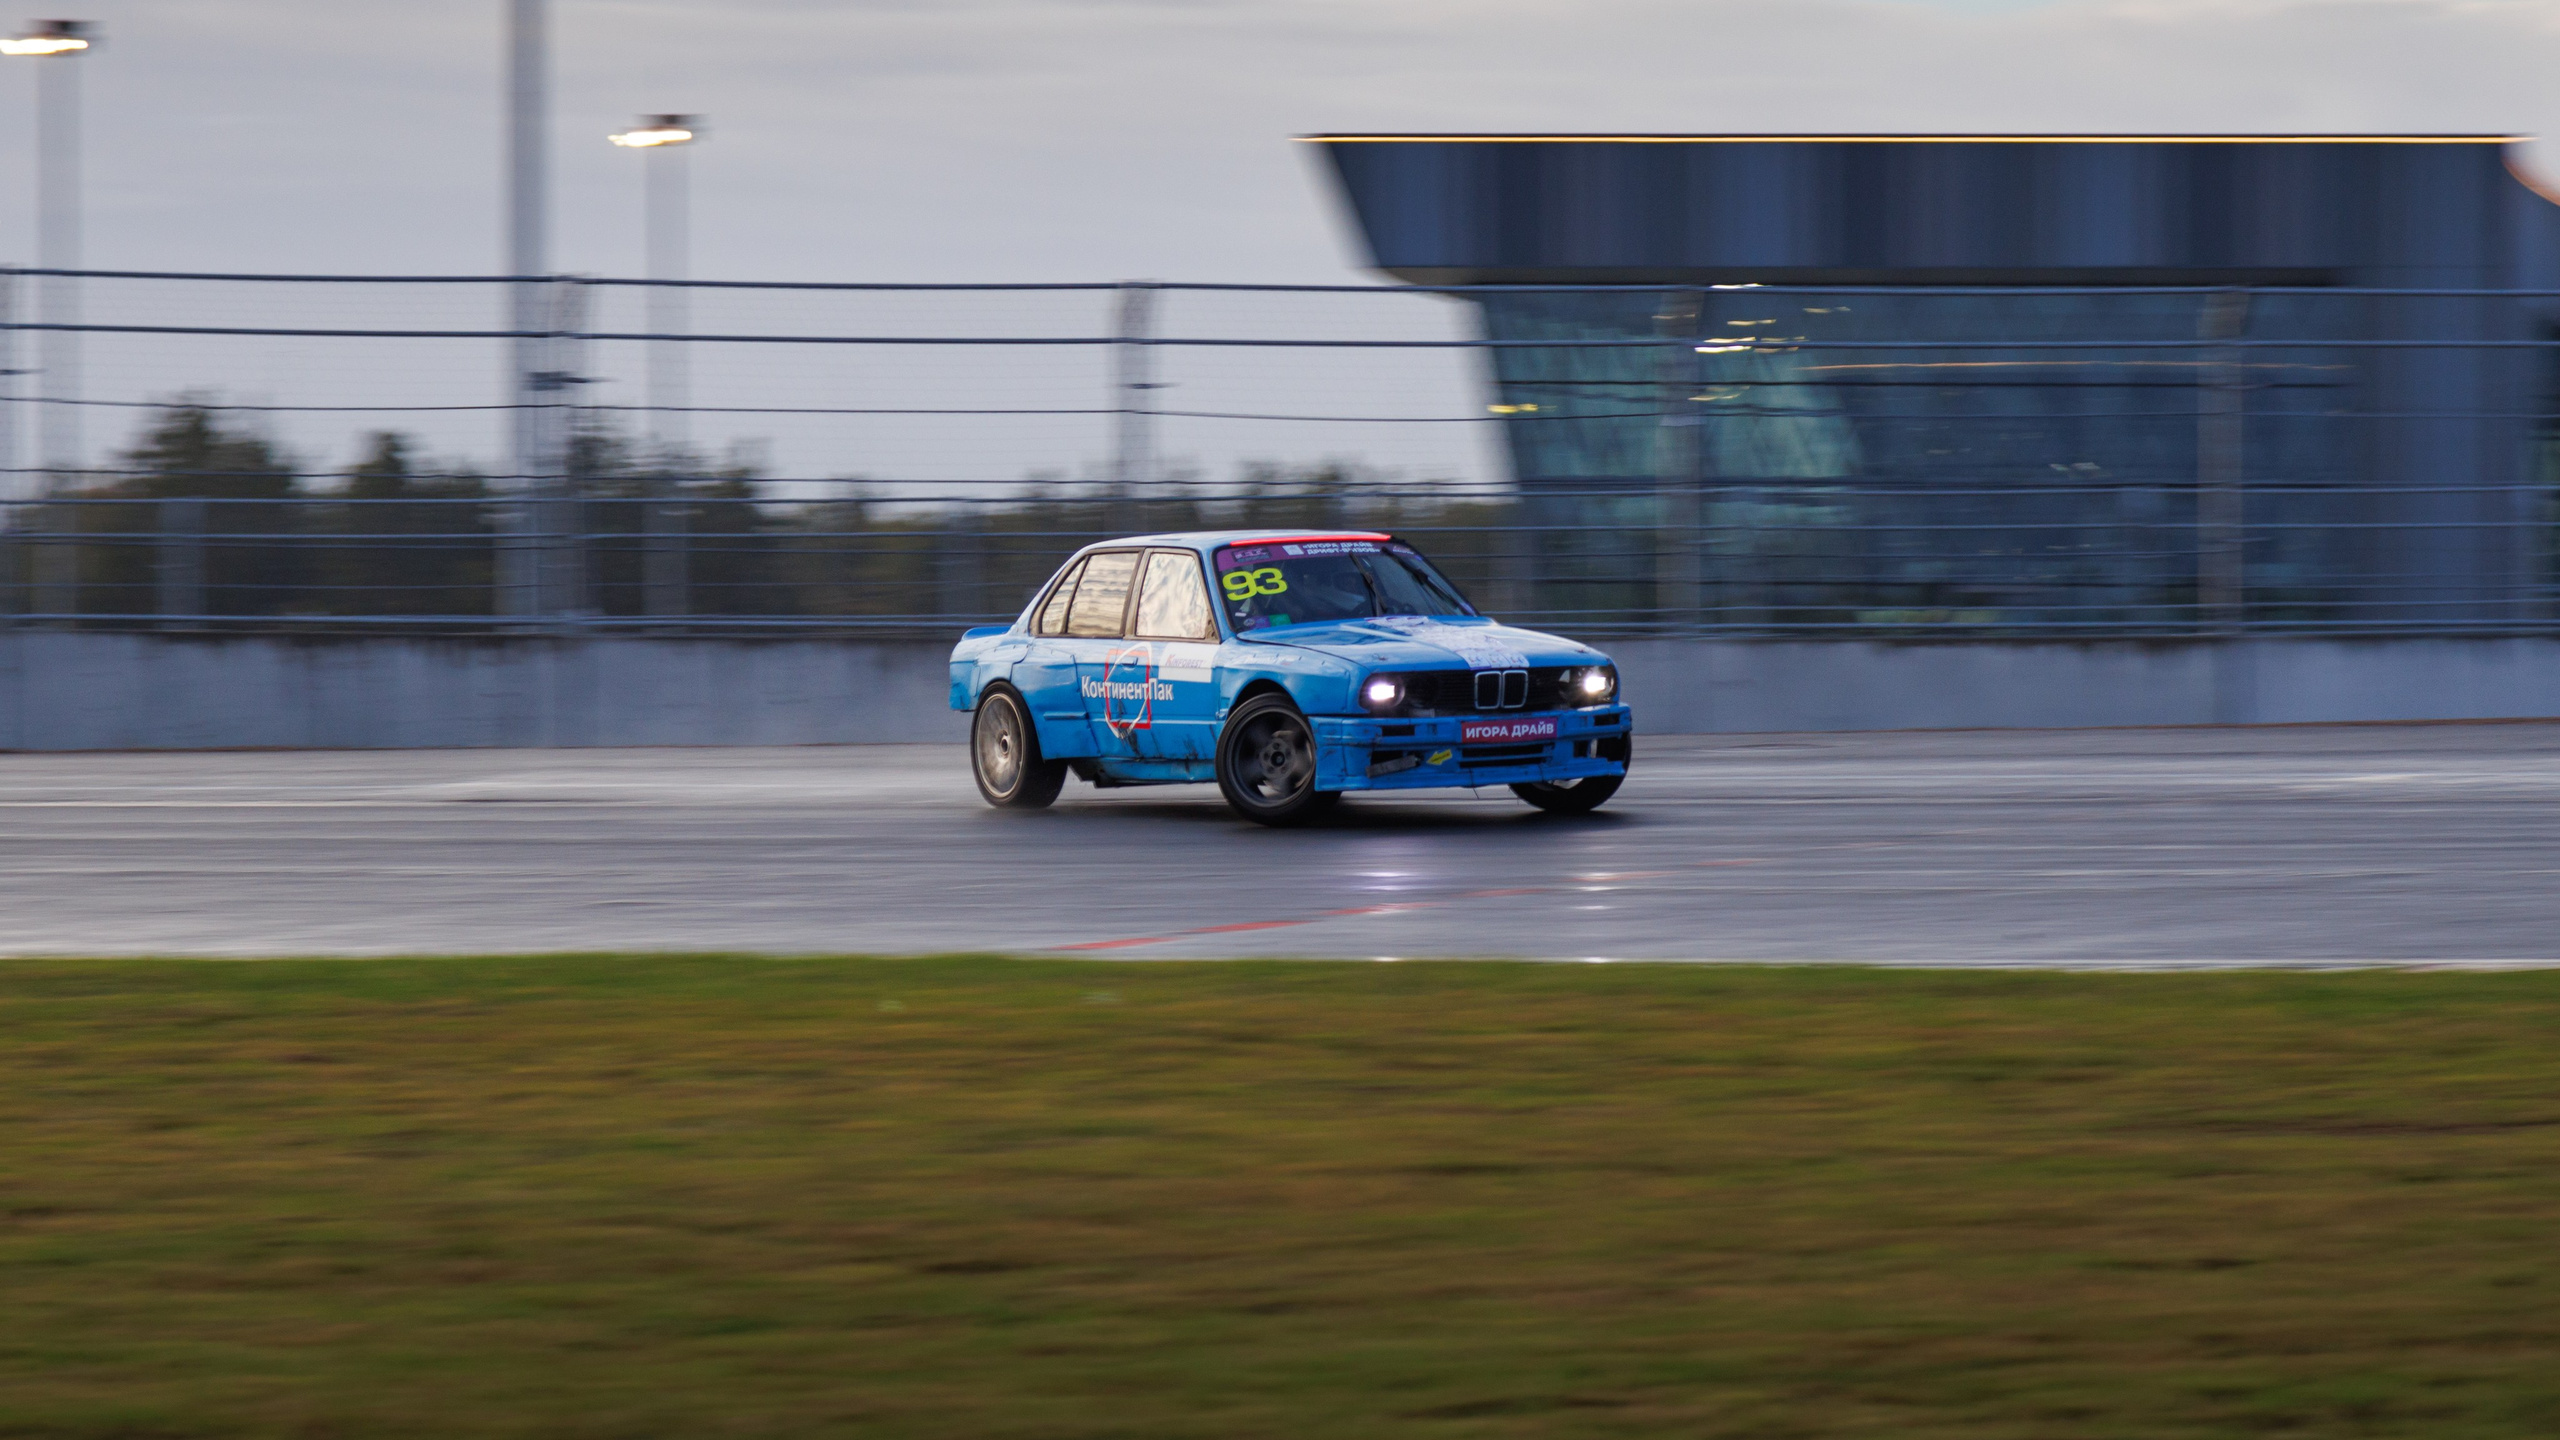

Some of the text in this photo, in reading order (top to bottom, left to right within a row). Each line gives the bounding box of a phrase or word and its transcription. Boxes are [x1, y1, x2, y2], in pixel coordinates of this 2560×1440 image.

[1223, 568, 1287, 600] 93
[1082, 675, 1173, 700] КонтинентПак
[1466, 722, 1554, 738] ИГОРА ДРАЙВ
